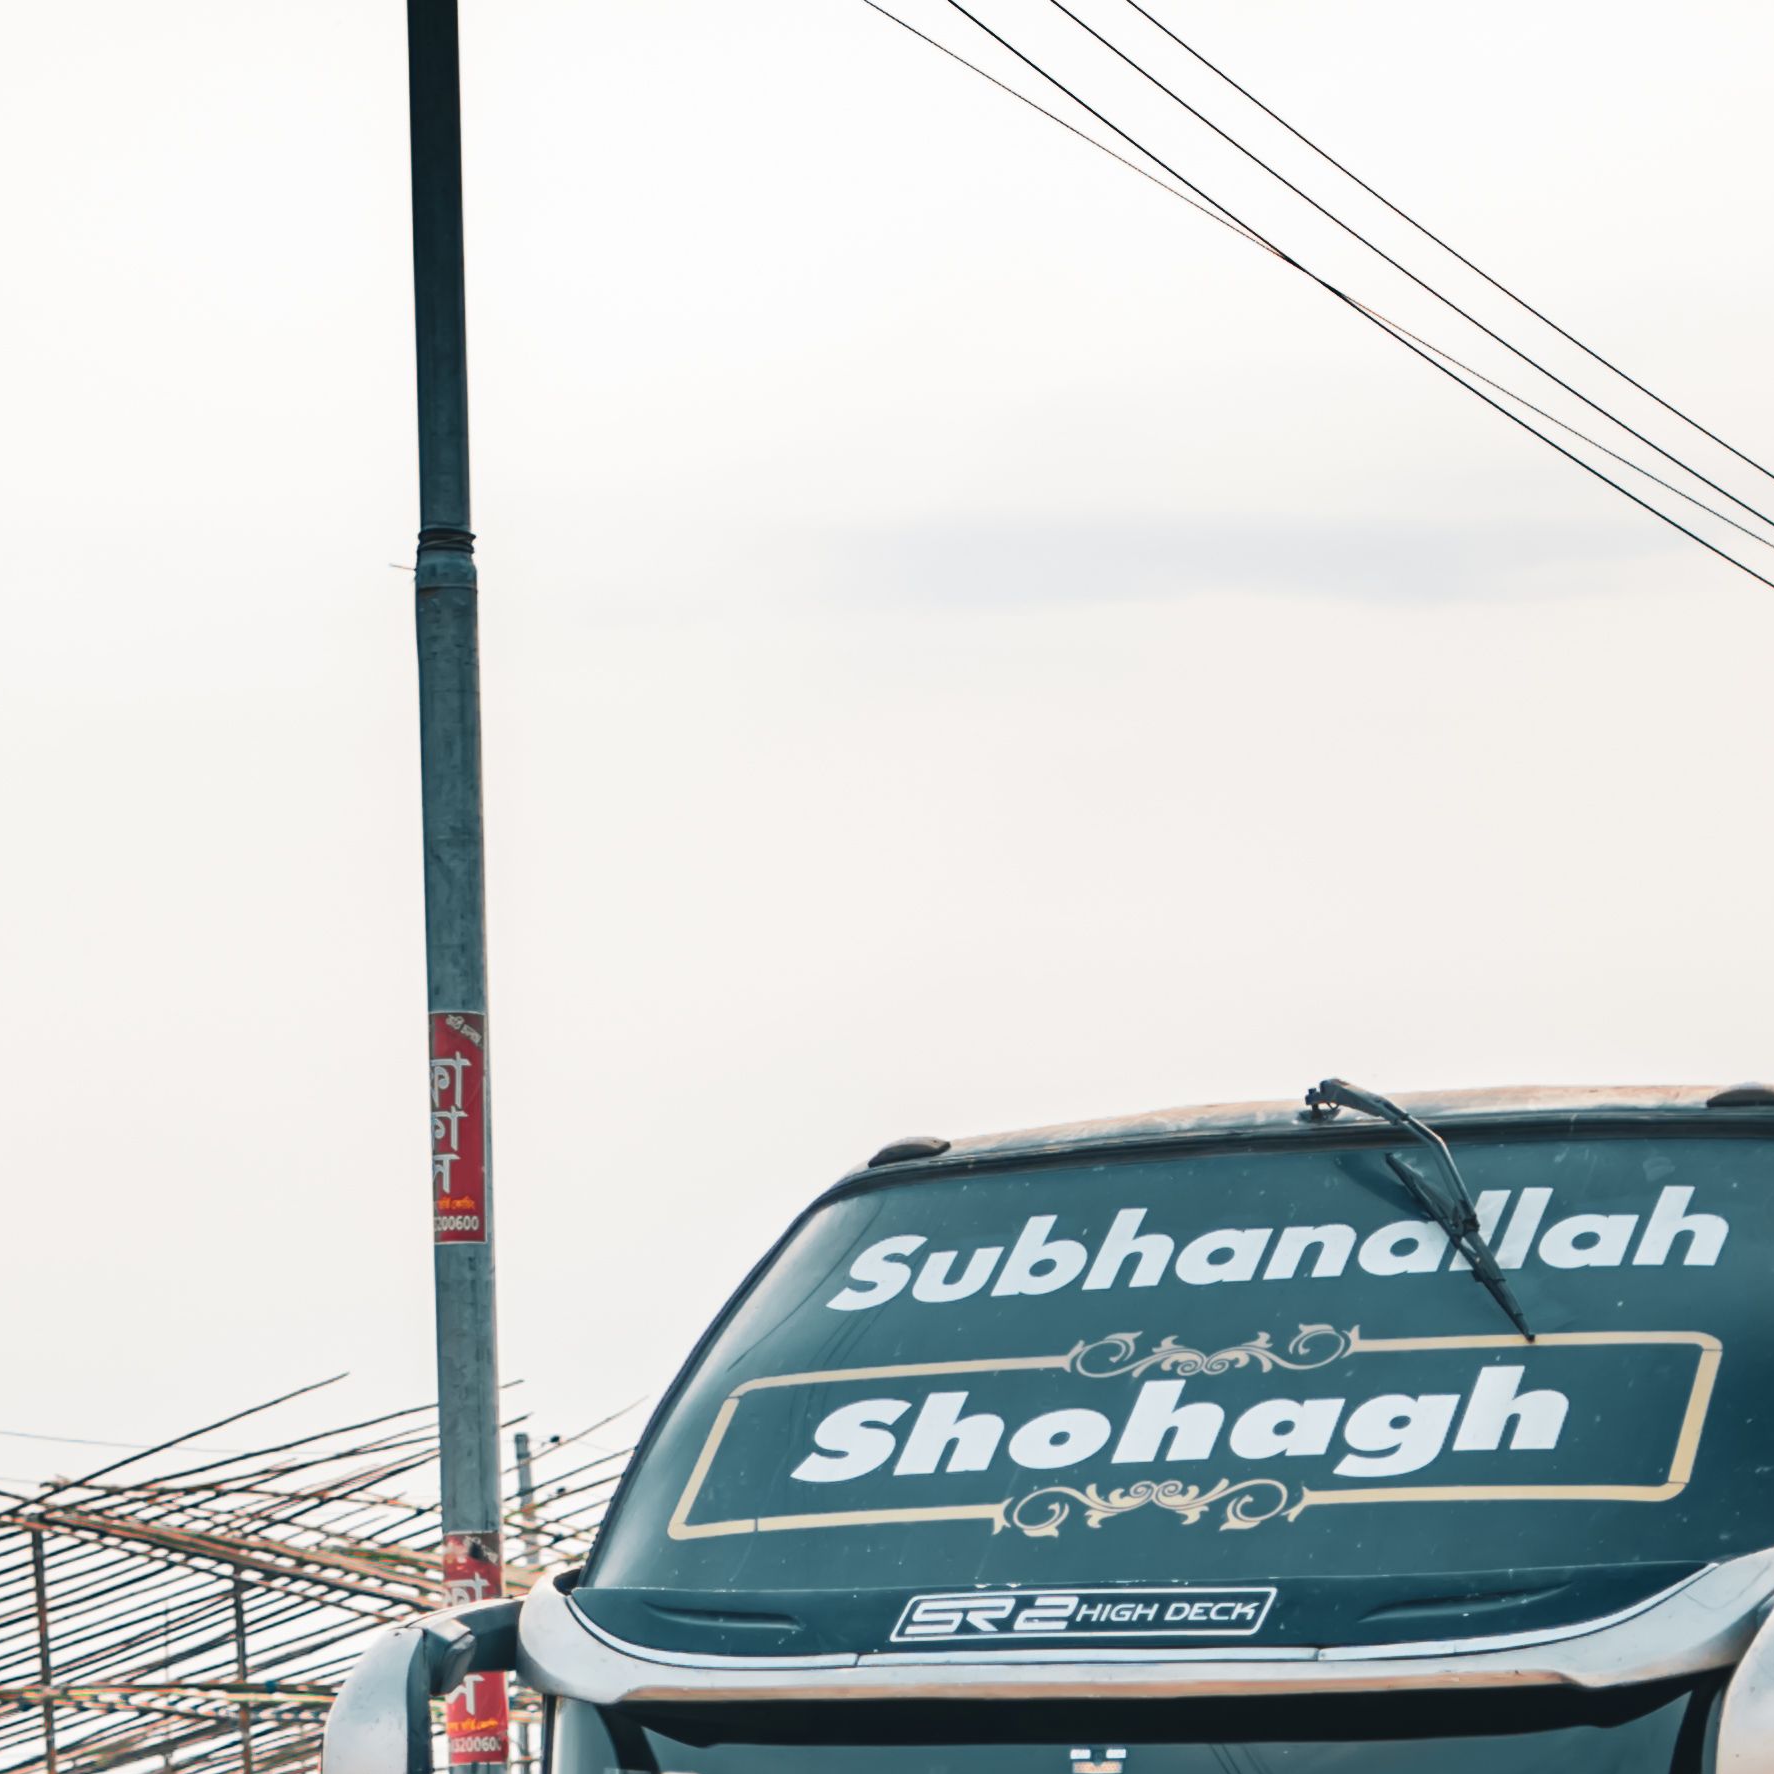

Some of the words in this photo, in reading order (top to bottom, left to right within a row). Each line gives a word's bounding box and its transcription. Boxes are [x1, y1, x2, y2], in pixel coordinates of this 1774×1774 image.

[827, 1186, 1730, 1311] Subhanallah
[791, 1366, 1570, 1483] Shohagh
[1076, 1603, 1155, 1622] HIGH
[1164, 1602, 1260, 1621] DECK
